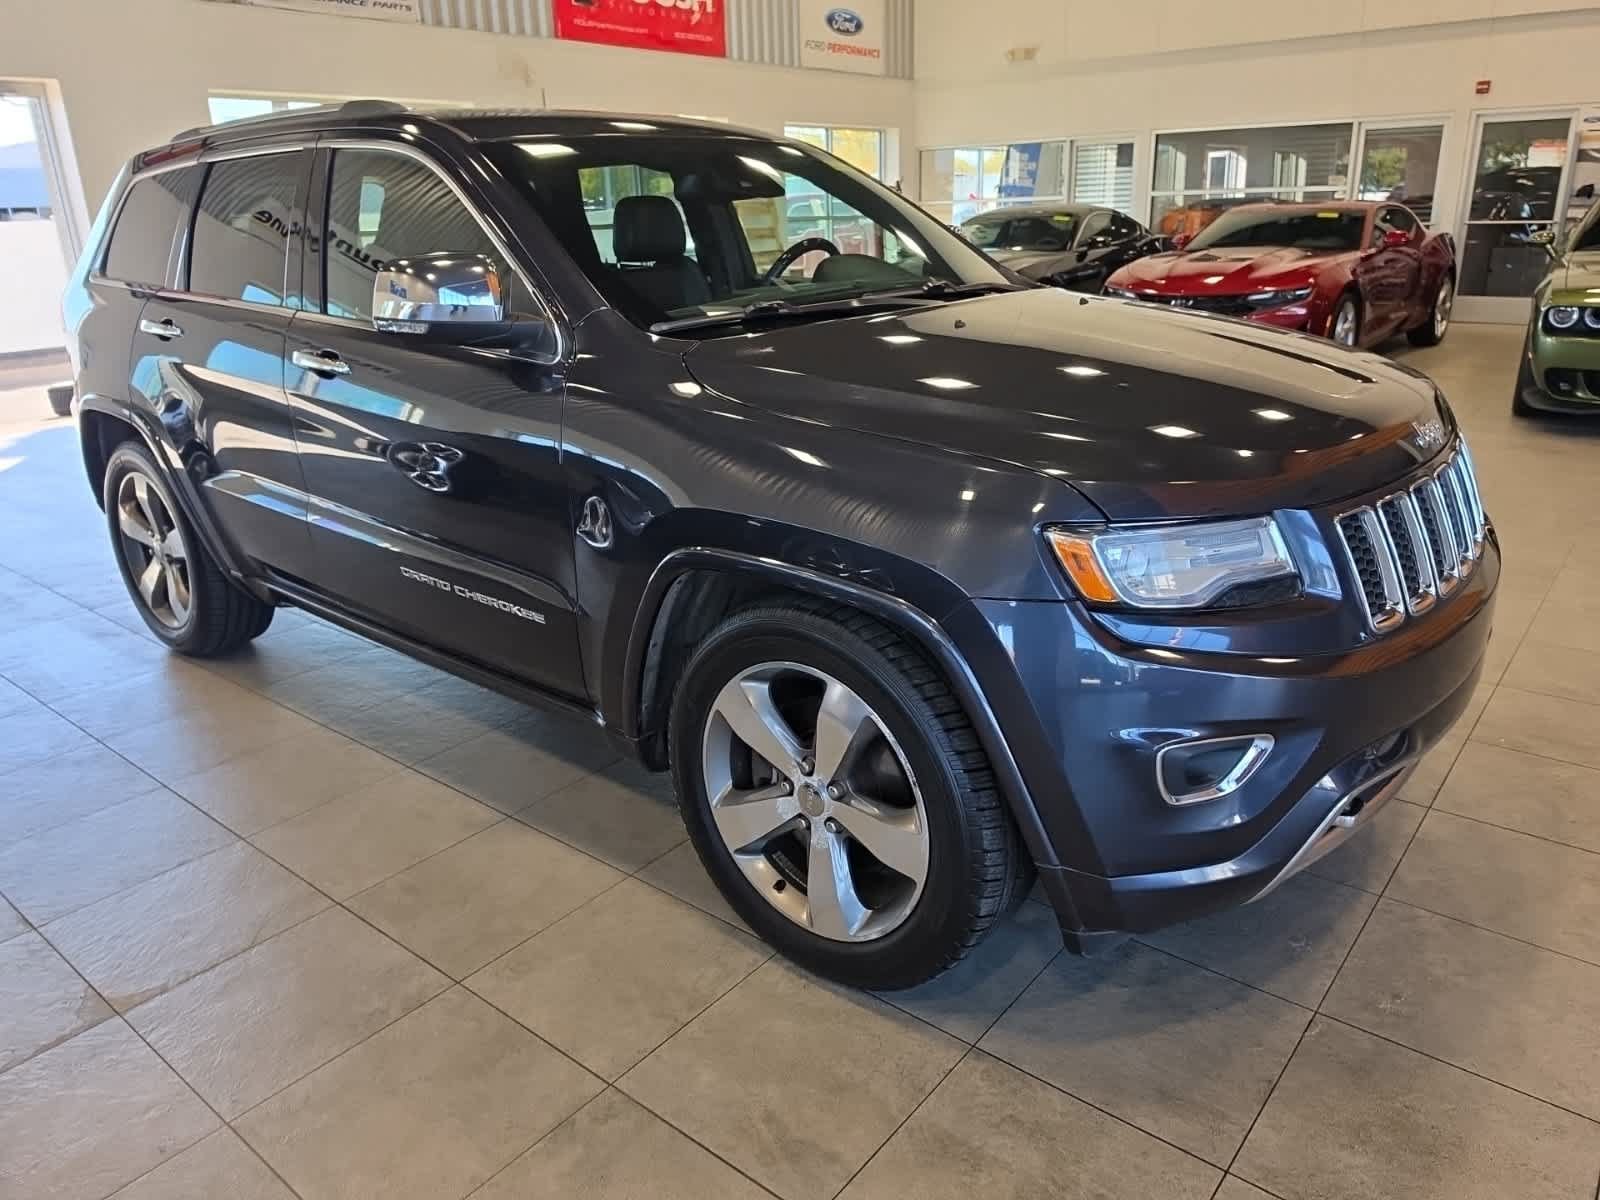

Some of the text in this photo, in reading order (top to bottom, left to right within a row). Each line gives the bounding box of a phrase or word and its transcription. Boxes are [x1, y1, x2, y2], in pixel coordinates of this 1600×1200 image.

[372, 1, 412, 12] PARTS
[831, 11, 858, 33] Ford
[399, 566, 546, 625] GRAND CHEROKEE
